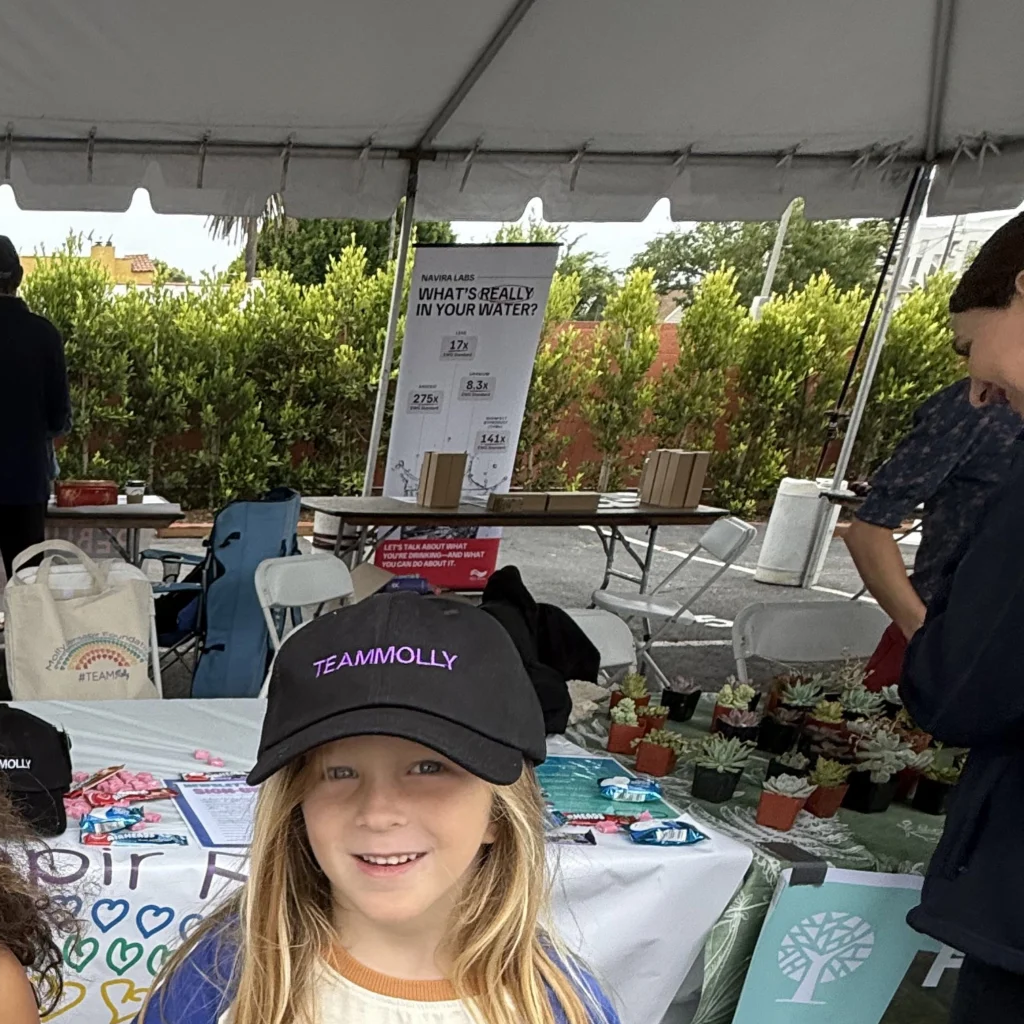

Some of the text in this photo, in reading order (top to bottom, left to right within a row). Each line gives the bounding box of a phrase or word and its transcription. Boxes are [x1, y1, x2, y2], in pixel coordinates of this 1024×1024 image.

[418, 286, 535, 301] WHAT'S REALLY
[416, 303, 538, 316] IN YOUR WATER?
[449, 340, 469, 350] 17x
[466, 380, 488, 390] 8.3x
[412, 394, 439, 404] 275x
[480, 434, 506, 444] 141x
[45, 643, 66, 671] Molly
[313, 646, 458, 678] TEAMMOLLY
[29, 847, 164, 890] pir
